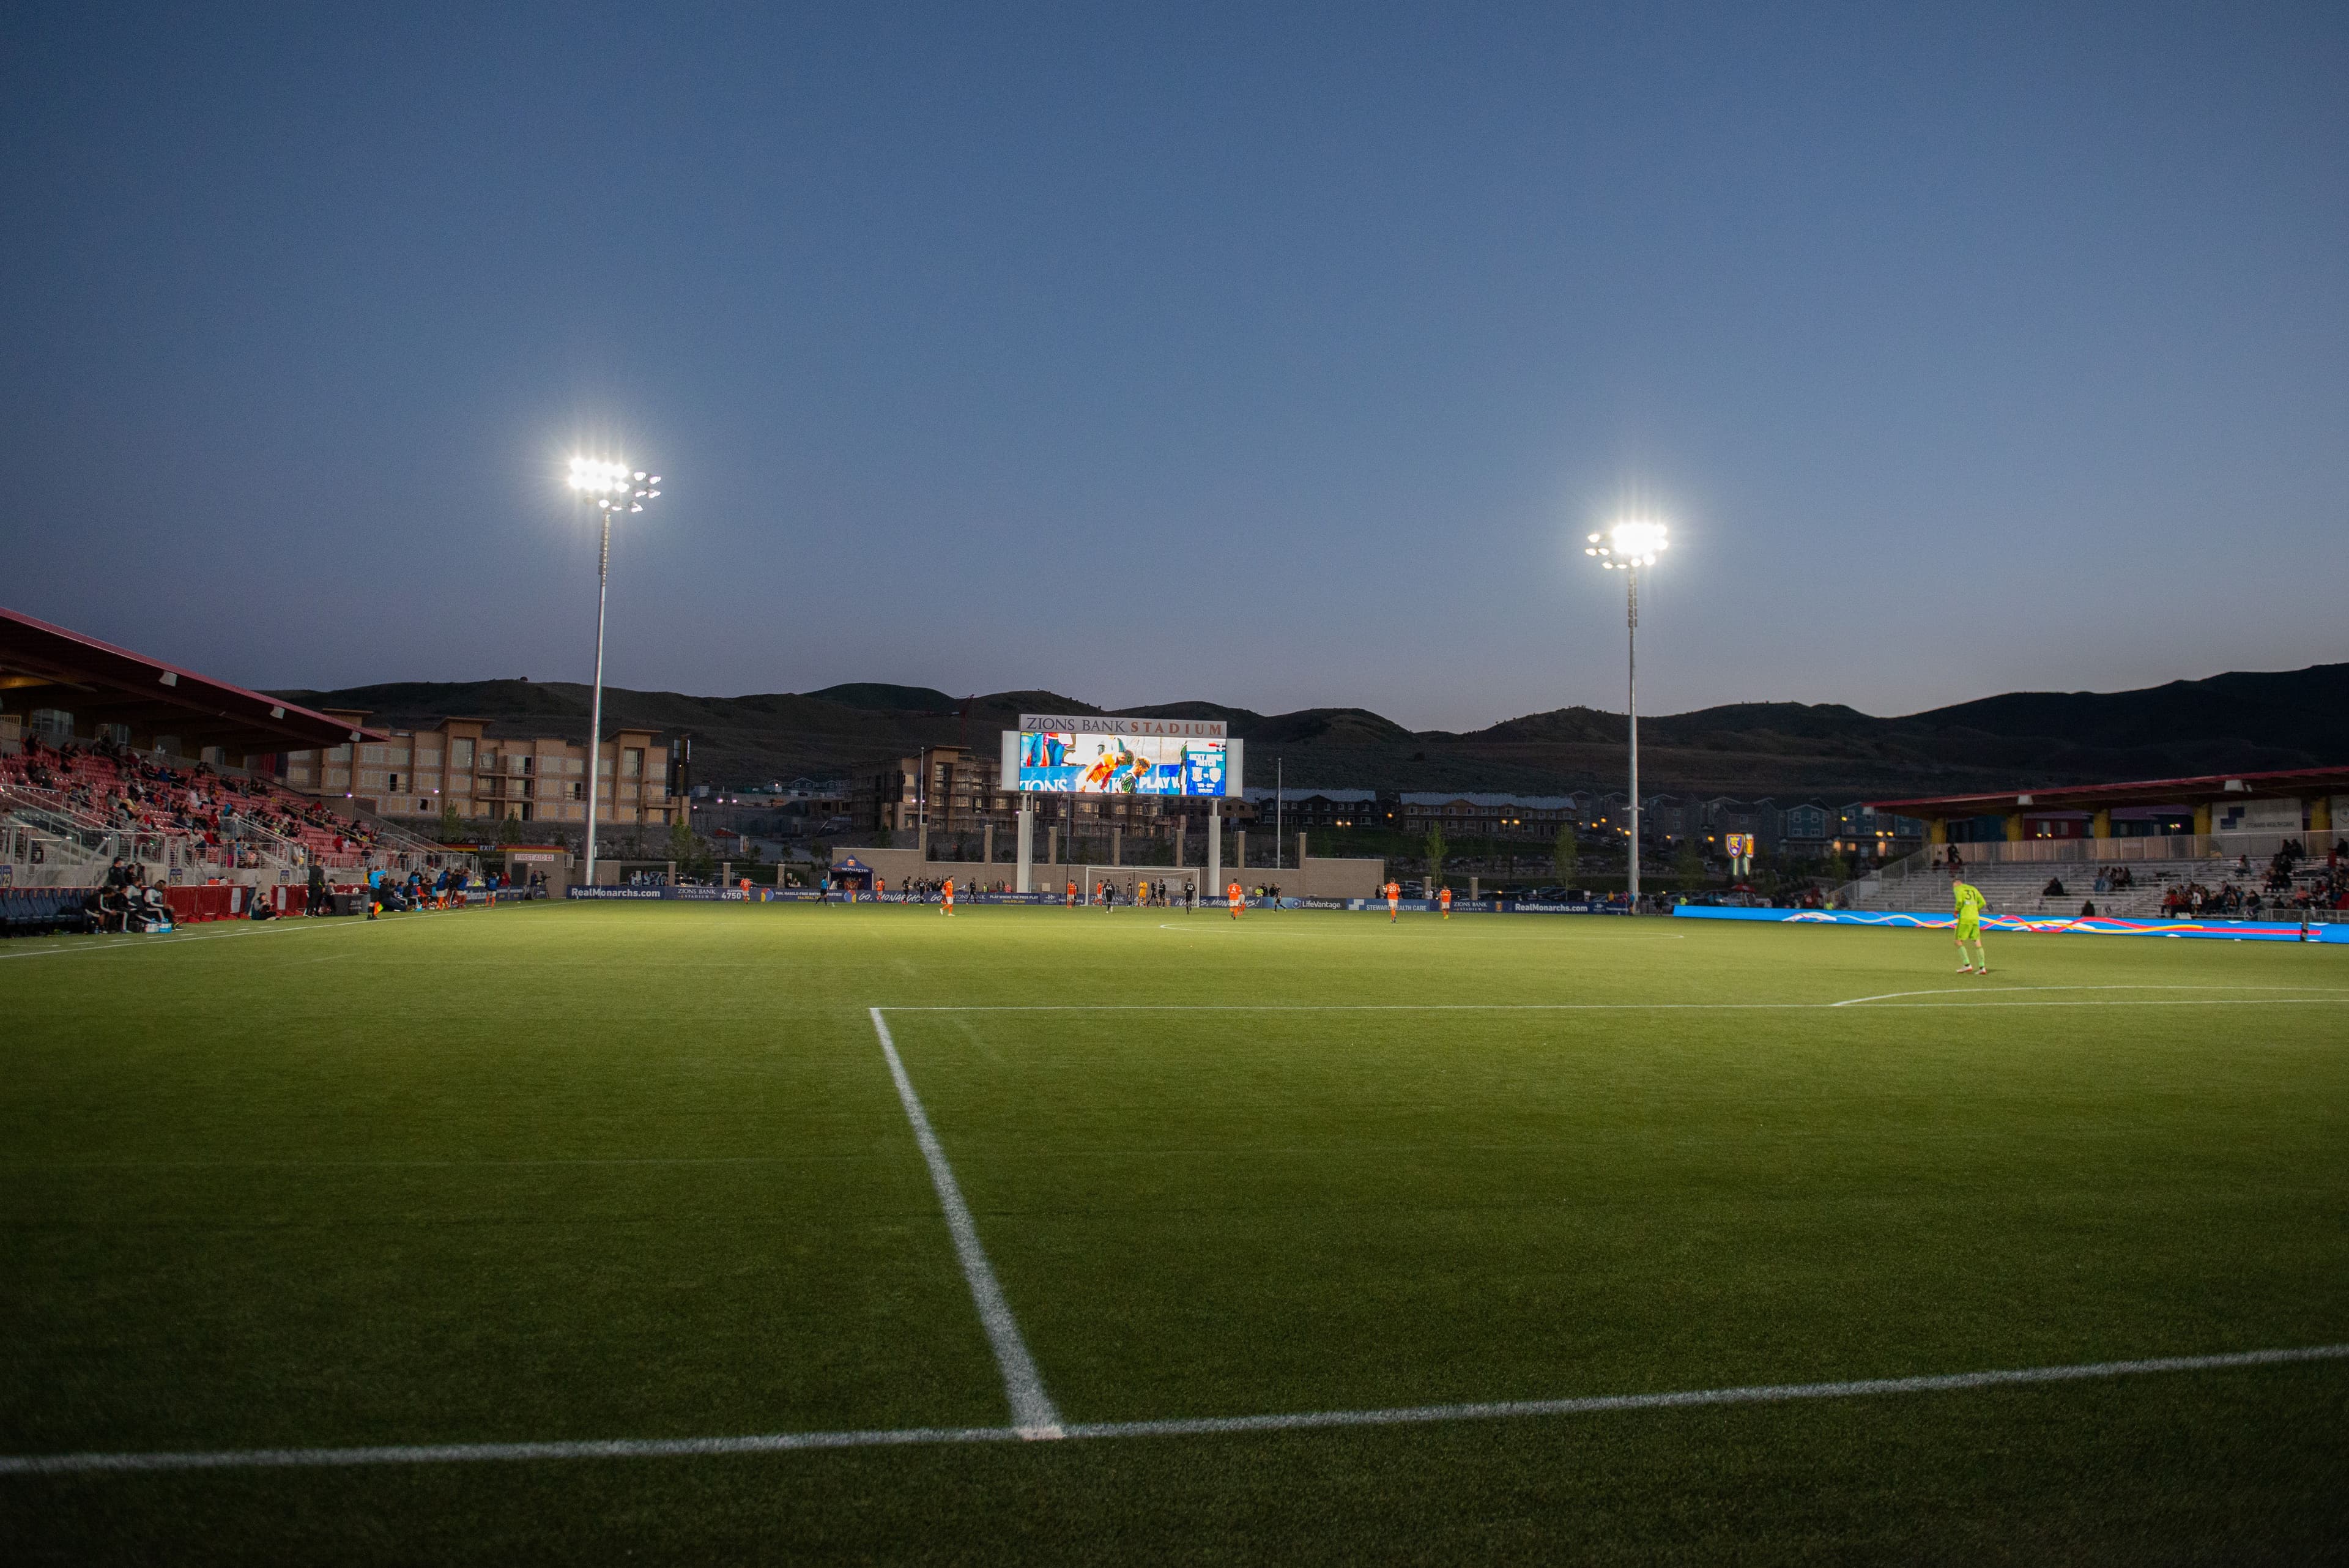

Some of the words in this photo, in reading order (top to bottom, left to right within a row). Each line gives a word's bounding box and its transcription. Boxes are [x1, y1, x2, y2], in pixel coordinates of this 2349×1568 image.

[1027, 718, 1075, 730] ZIONS
[1082, 719, 1126, 733] BANK
[1131, 722, 1222, 735] STADIUM
[571, 888, 660, 897] RealMonarchs.com
[1964, 890, 1976, 901] 31
[1302, 901, 1341, 909] LifeVantage
